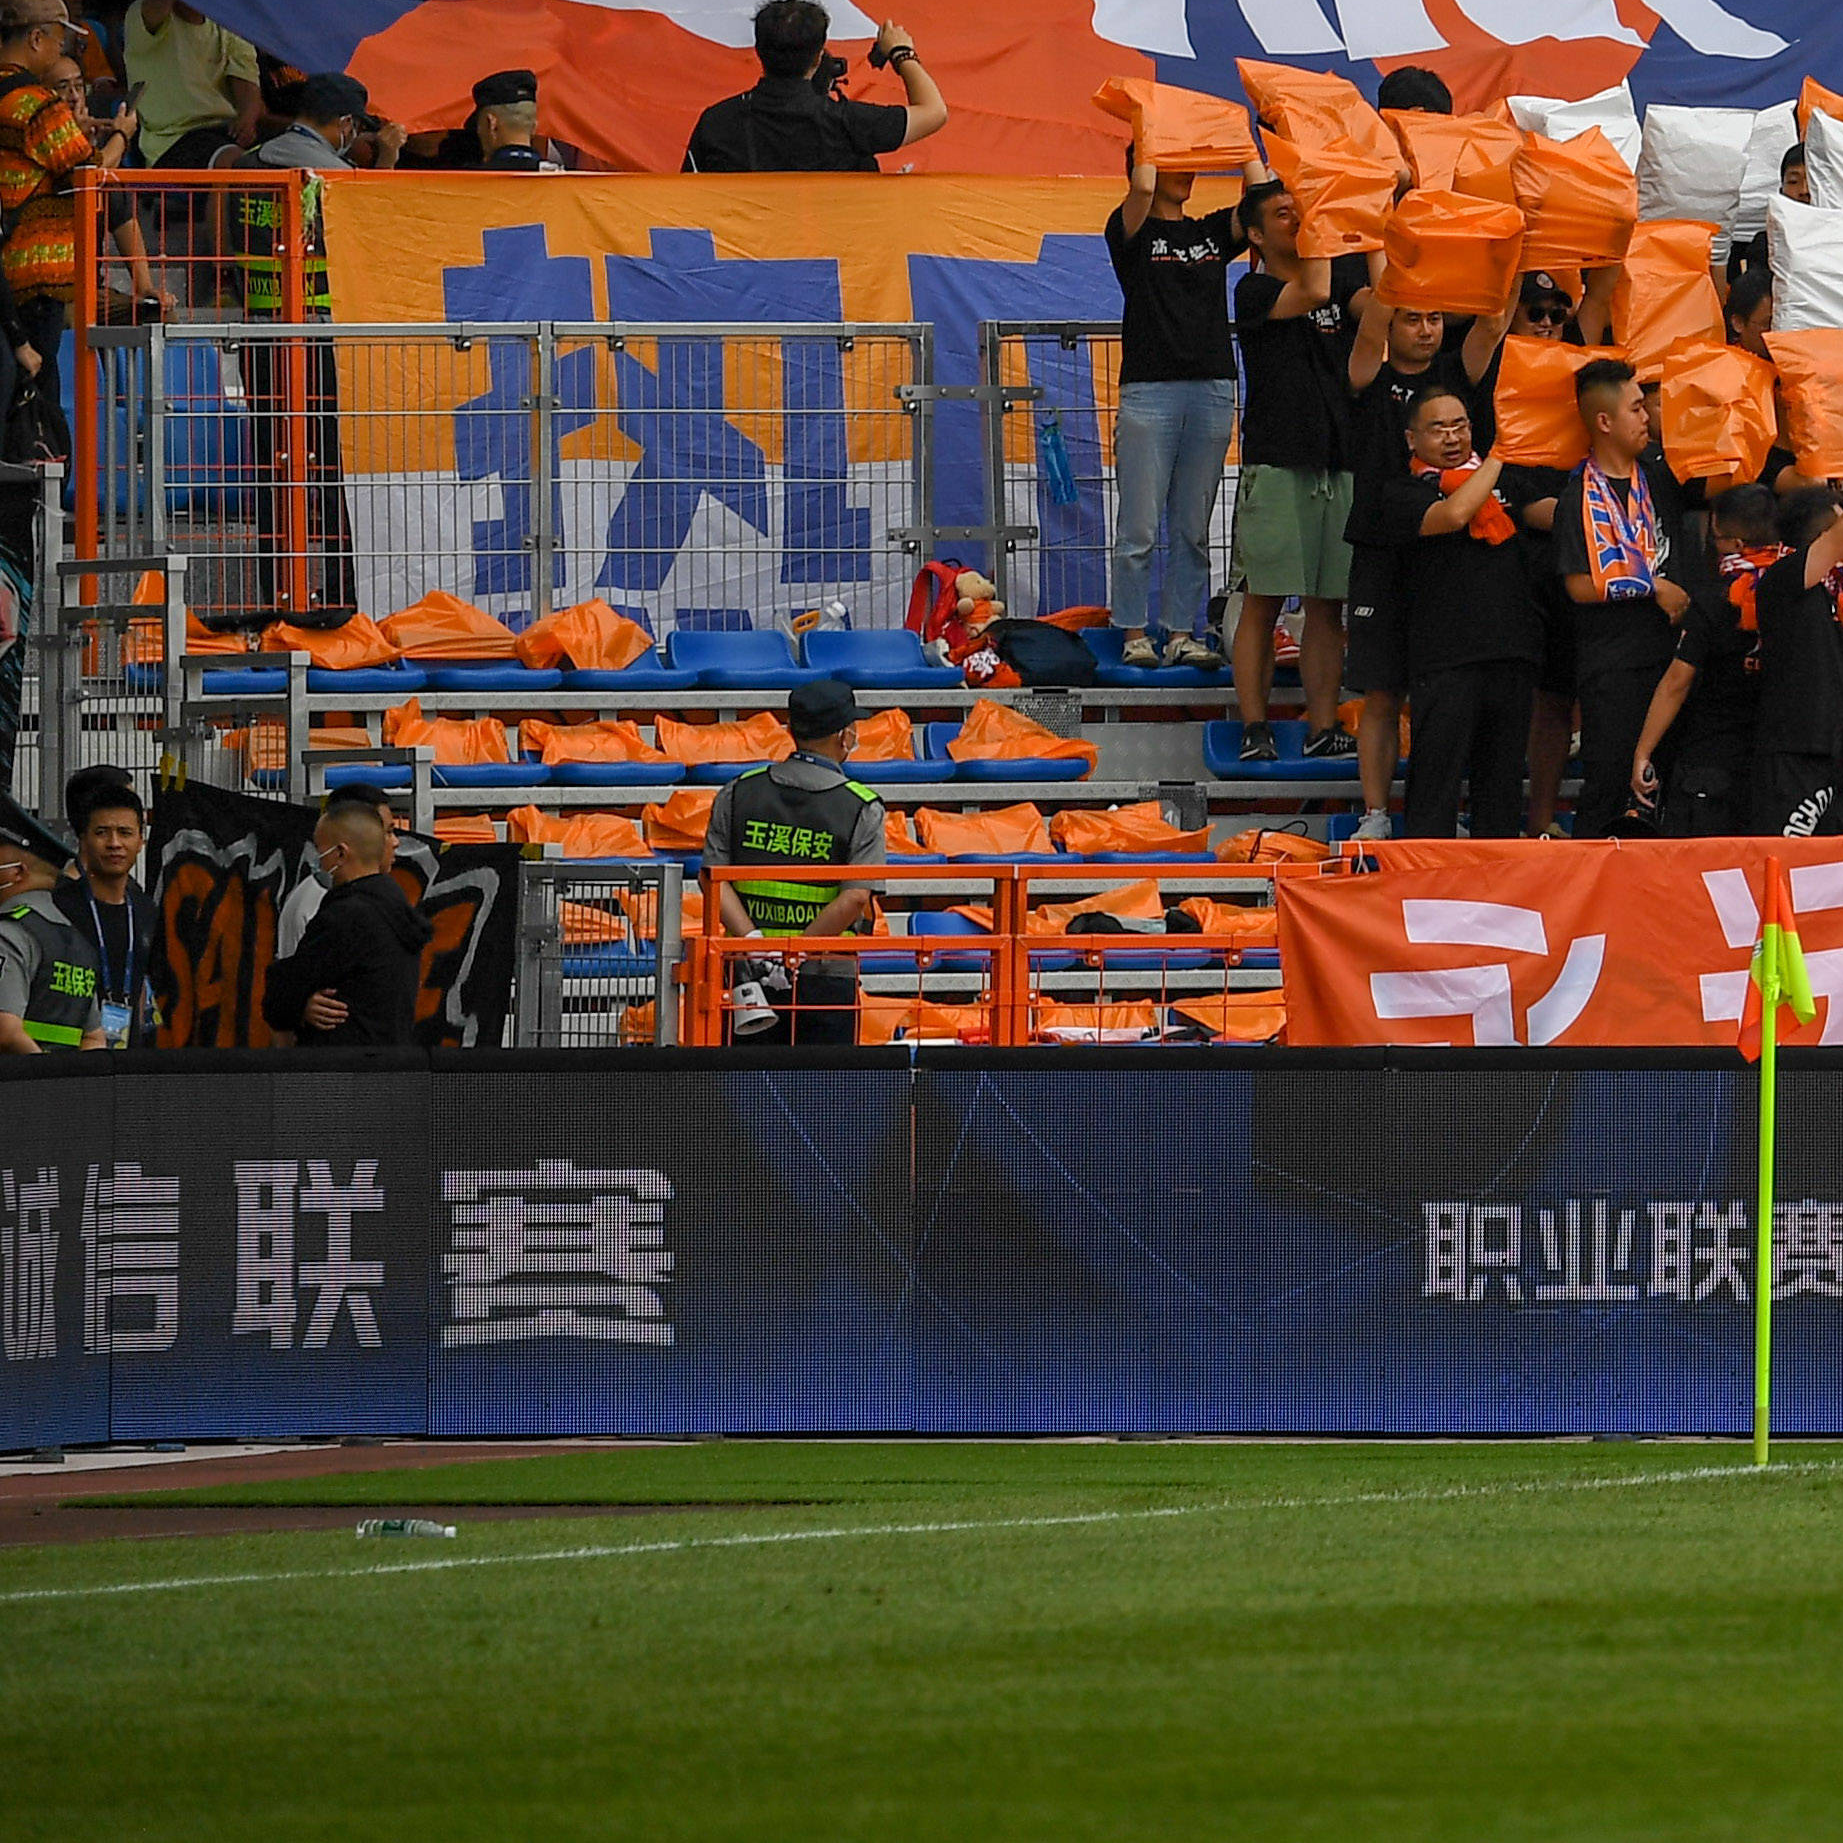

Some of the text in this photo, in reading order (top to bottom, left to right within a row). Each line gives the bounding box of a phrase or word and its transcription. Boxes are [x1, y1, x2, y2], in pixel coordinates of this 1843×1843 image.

[742, 819, 834, 861] 玉溪保安
[1, 1158, 675, 1360] 诚信联赛
